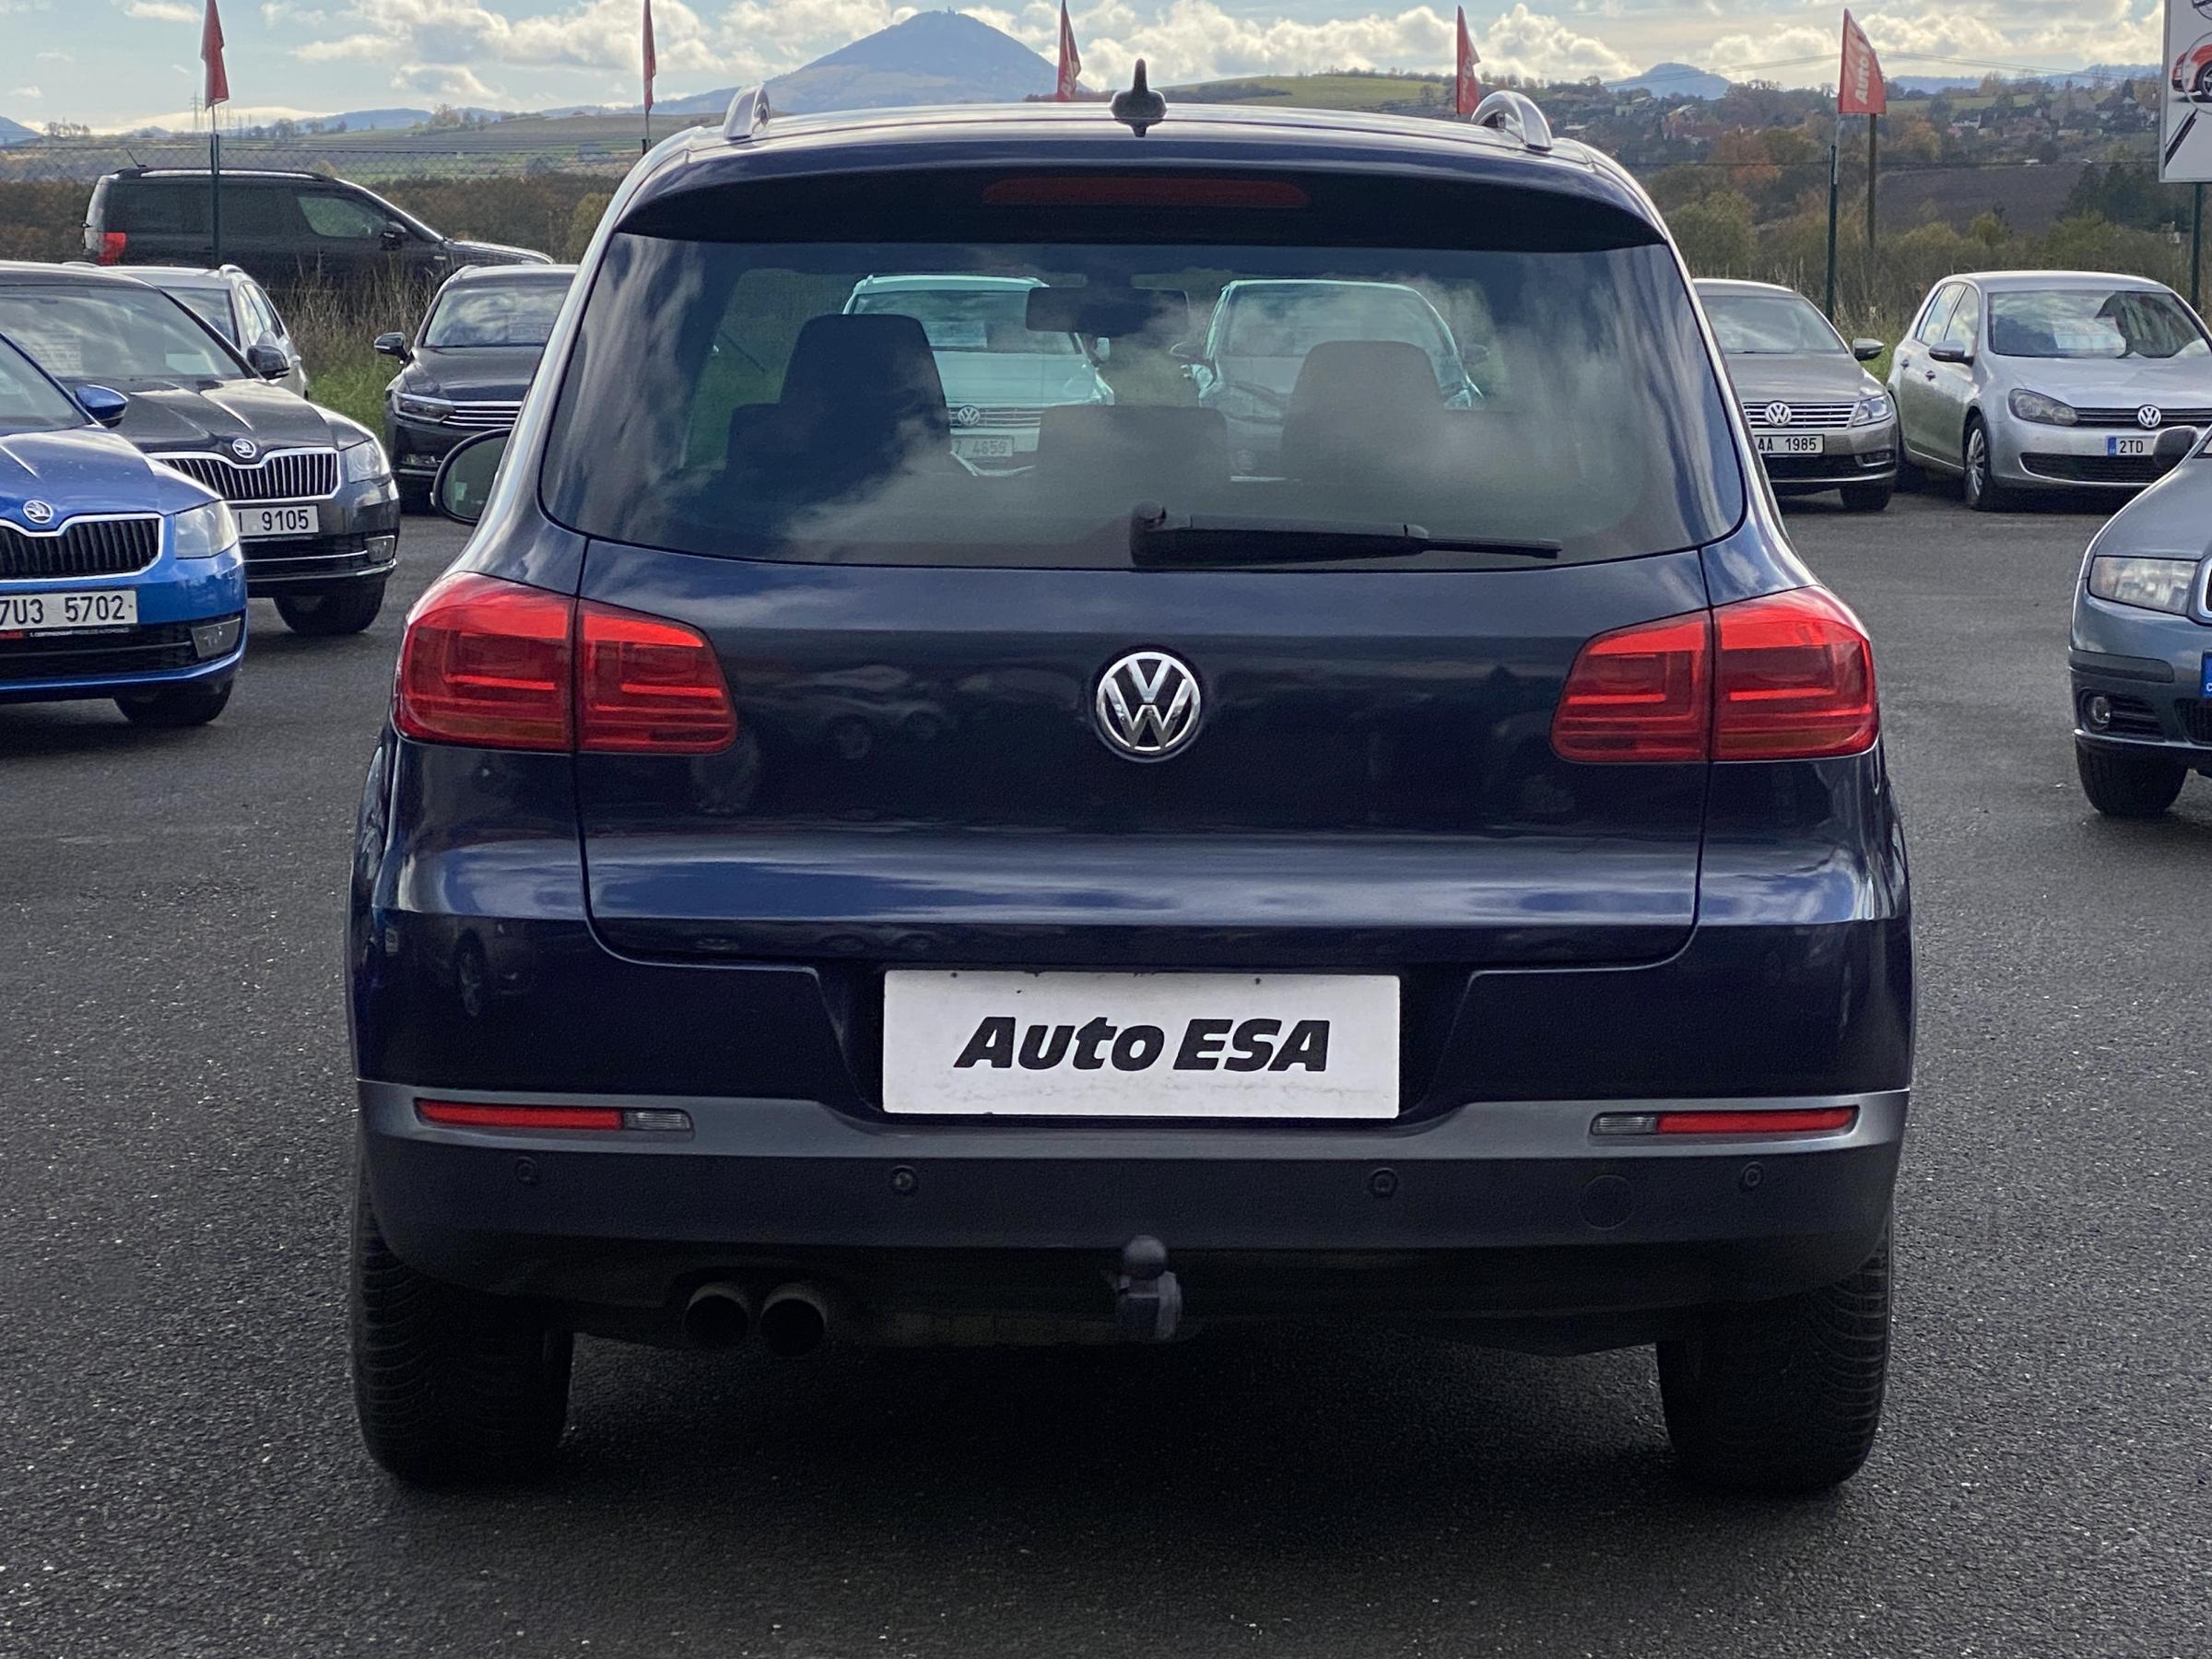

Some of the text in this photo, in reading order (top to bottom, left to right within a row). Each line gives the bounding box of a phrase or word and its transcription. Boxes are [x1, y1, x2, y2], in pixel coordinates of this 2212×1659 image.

[1785, 438, 1817, 451] 1985
[2120, 441, 2143, 453] 2TD
[262, 509, 309, 532] 9105
[0, 594, 125, 626] 7U3 5702
[953, 1017, 1331, 1073] Auto ESA
